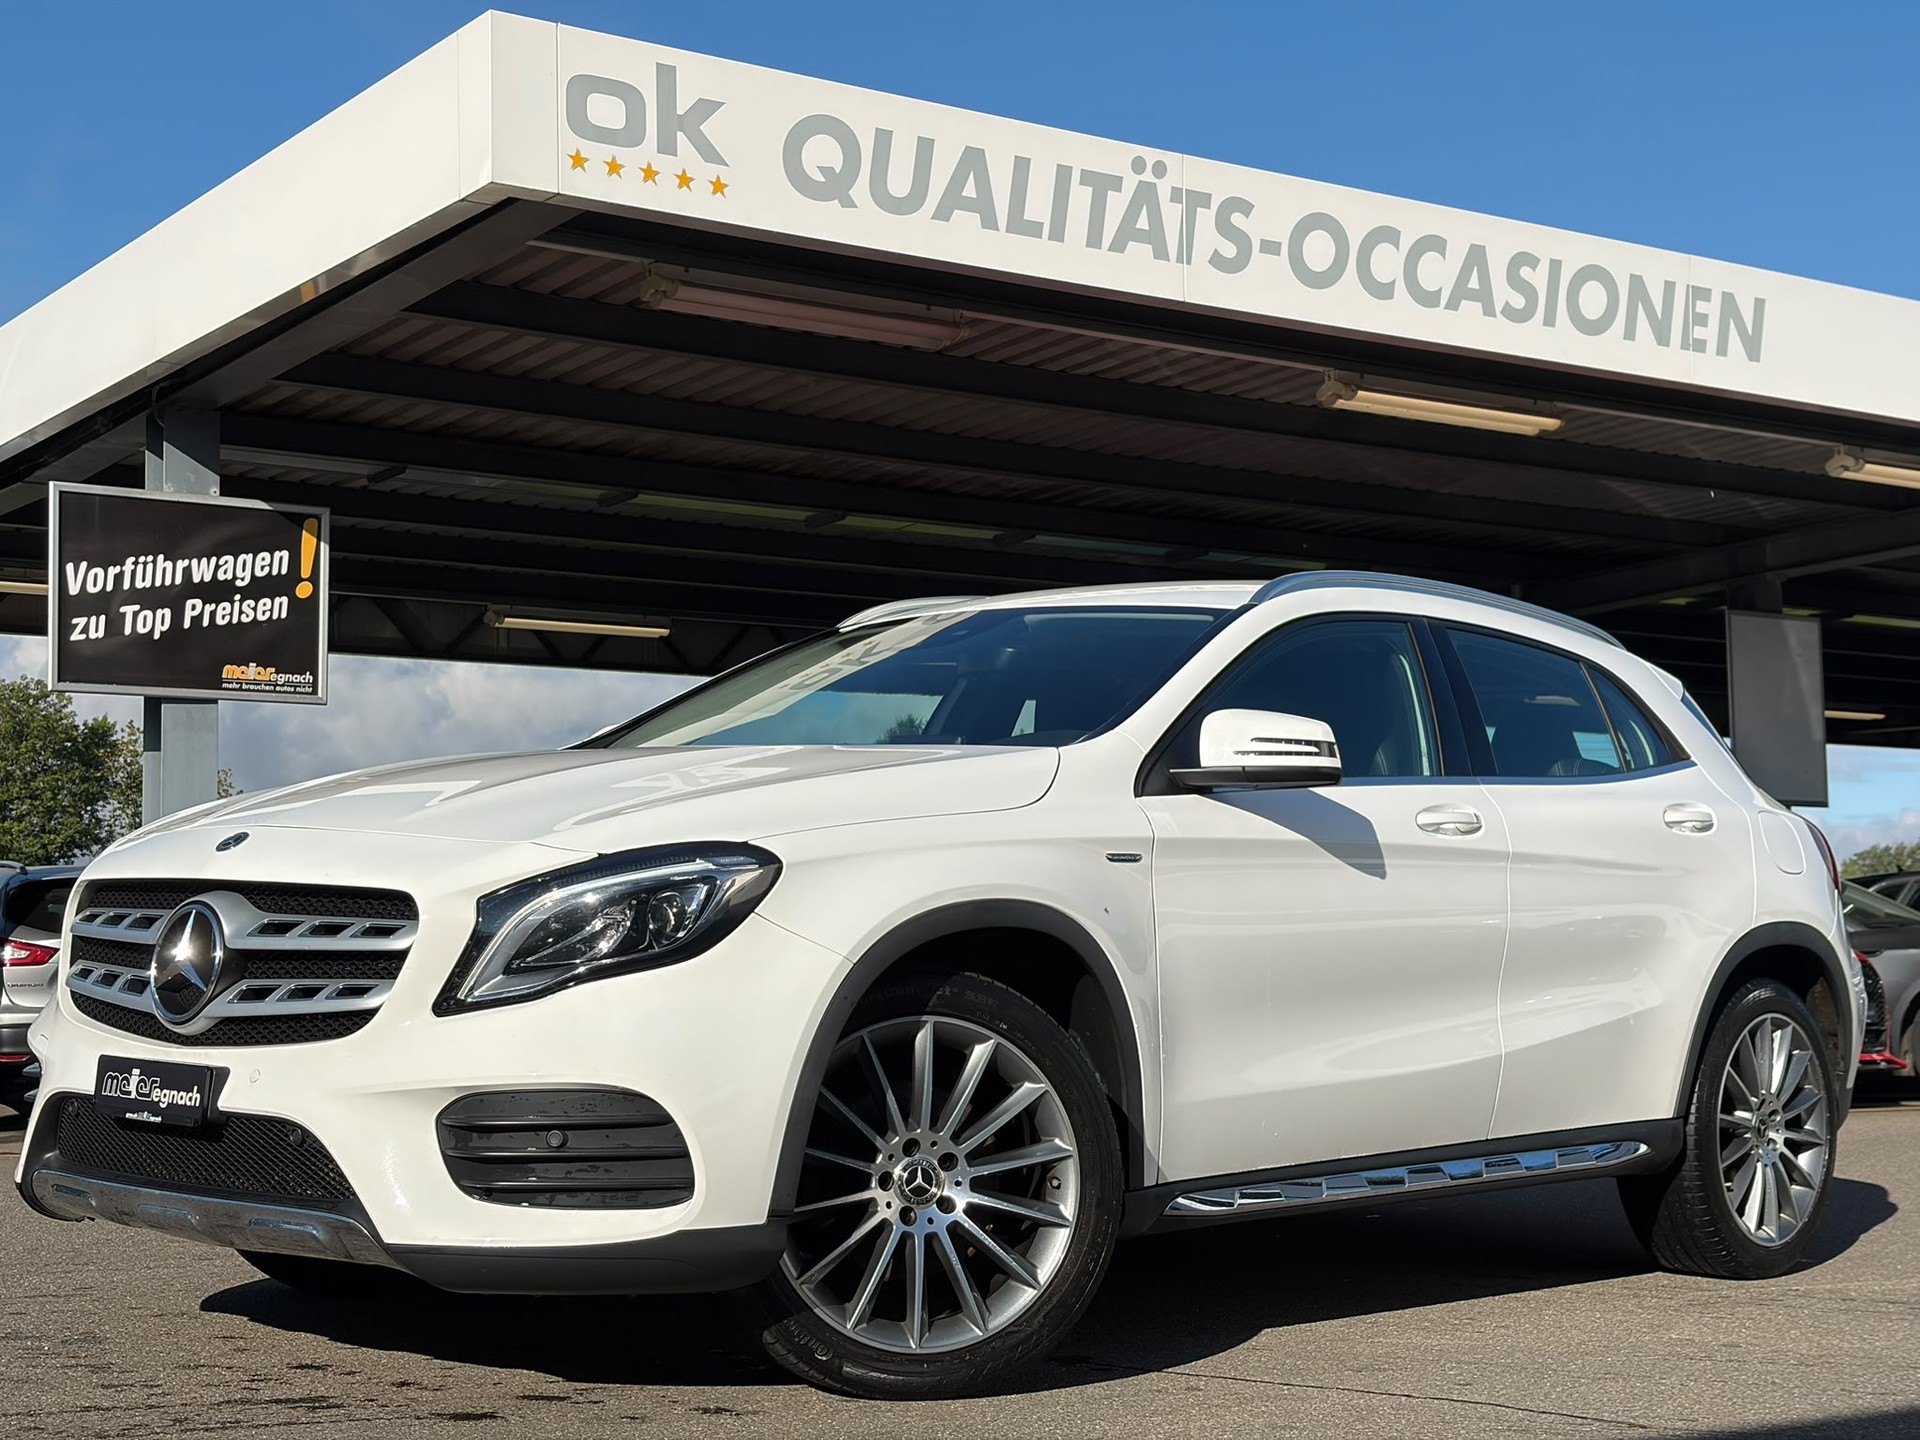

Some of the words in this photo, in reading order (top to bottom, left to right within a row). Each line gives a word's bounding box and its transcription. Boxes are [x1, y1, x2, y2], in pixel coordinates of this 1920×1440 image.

[565, 62, 730, 168] ok
[782, 113, 1767, 363] QUALITÄTS-OCCASIONEN
[65, 549, 290, 596] Vorführwagen
[69, 614, 106, 642] zu
[119, 604, 172, 640] Top
[183, 593, 289, 630] Preisen
[242, 683, 275, 691] brauchen
[296, 685, 313, 693] nicht
